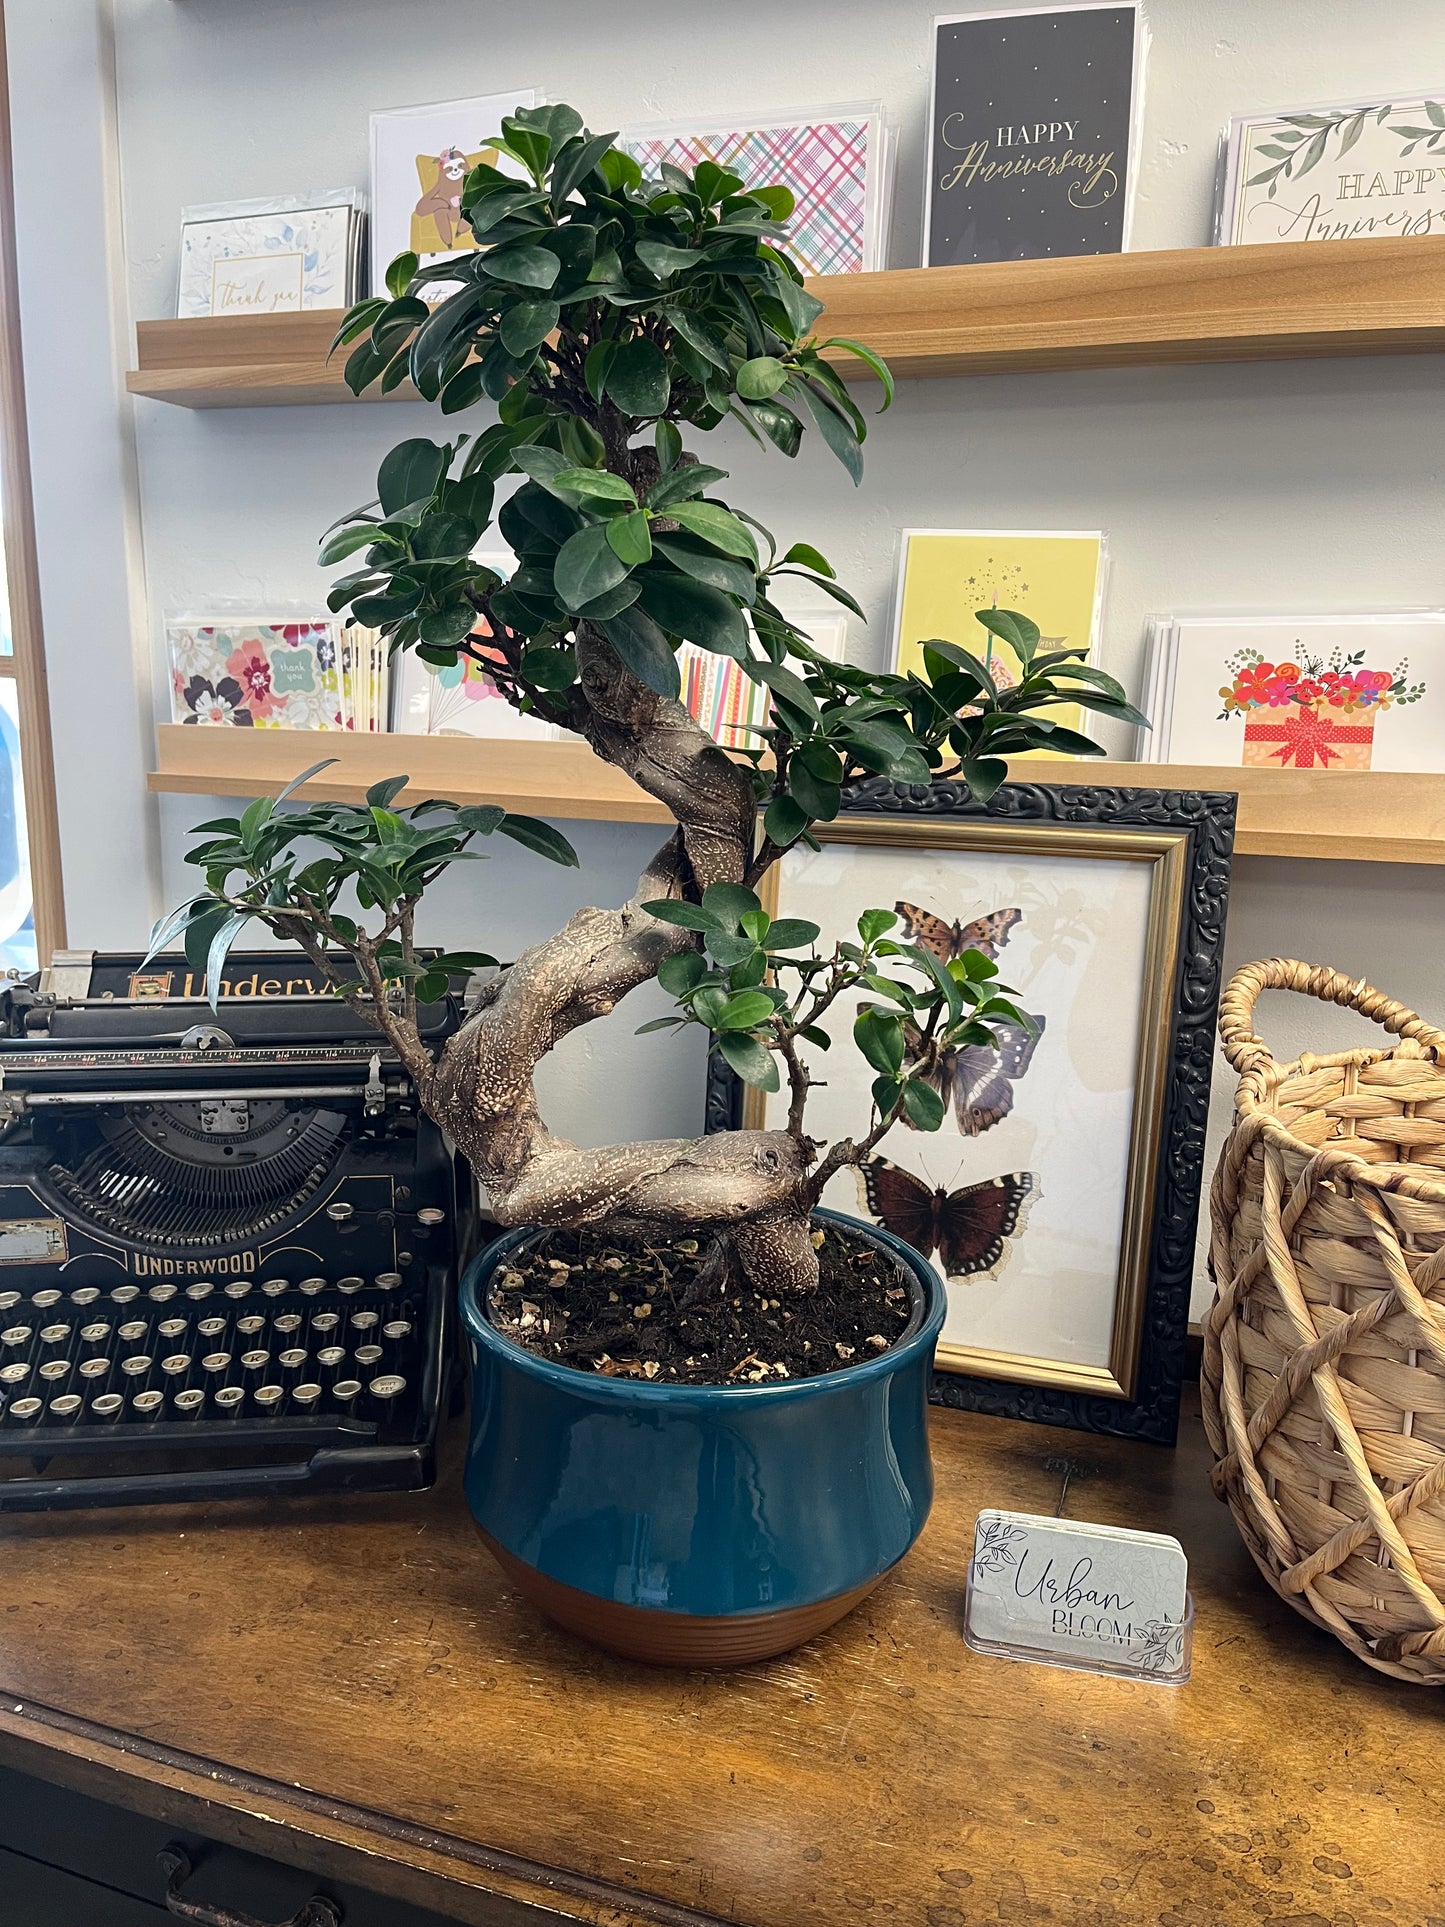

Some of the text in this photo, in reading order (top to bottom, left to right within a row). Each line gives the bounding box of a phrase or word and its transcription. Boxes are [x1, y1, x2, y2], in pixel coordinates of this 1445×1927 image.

[995, 120, 1080, 148] HAPPY
[940, 112, 1118, 209] Anniversary
[1248, 193, 1445, 241] Annivers
[280, 660, 306, 672] thank
[287, 673, 303, 682] you
[183, 972, 402, 997] Underw
[134, 1250, 255, 1276] UNDERWOOD
[1015, 1549, 1135, 1610] Urban
[1052, 1609, 1132, 1646] BLOOM
